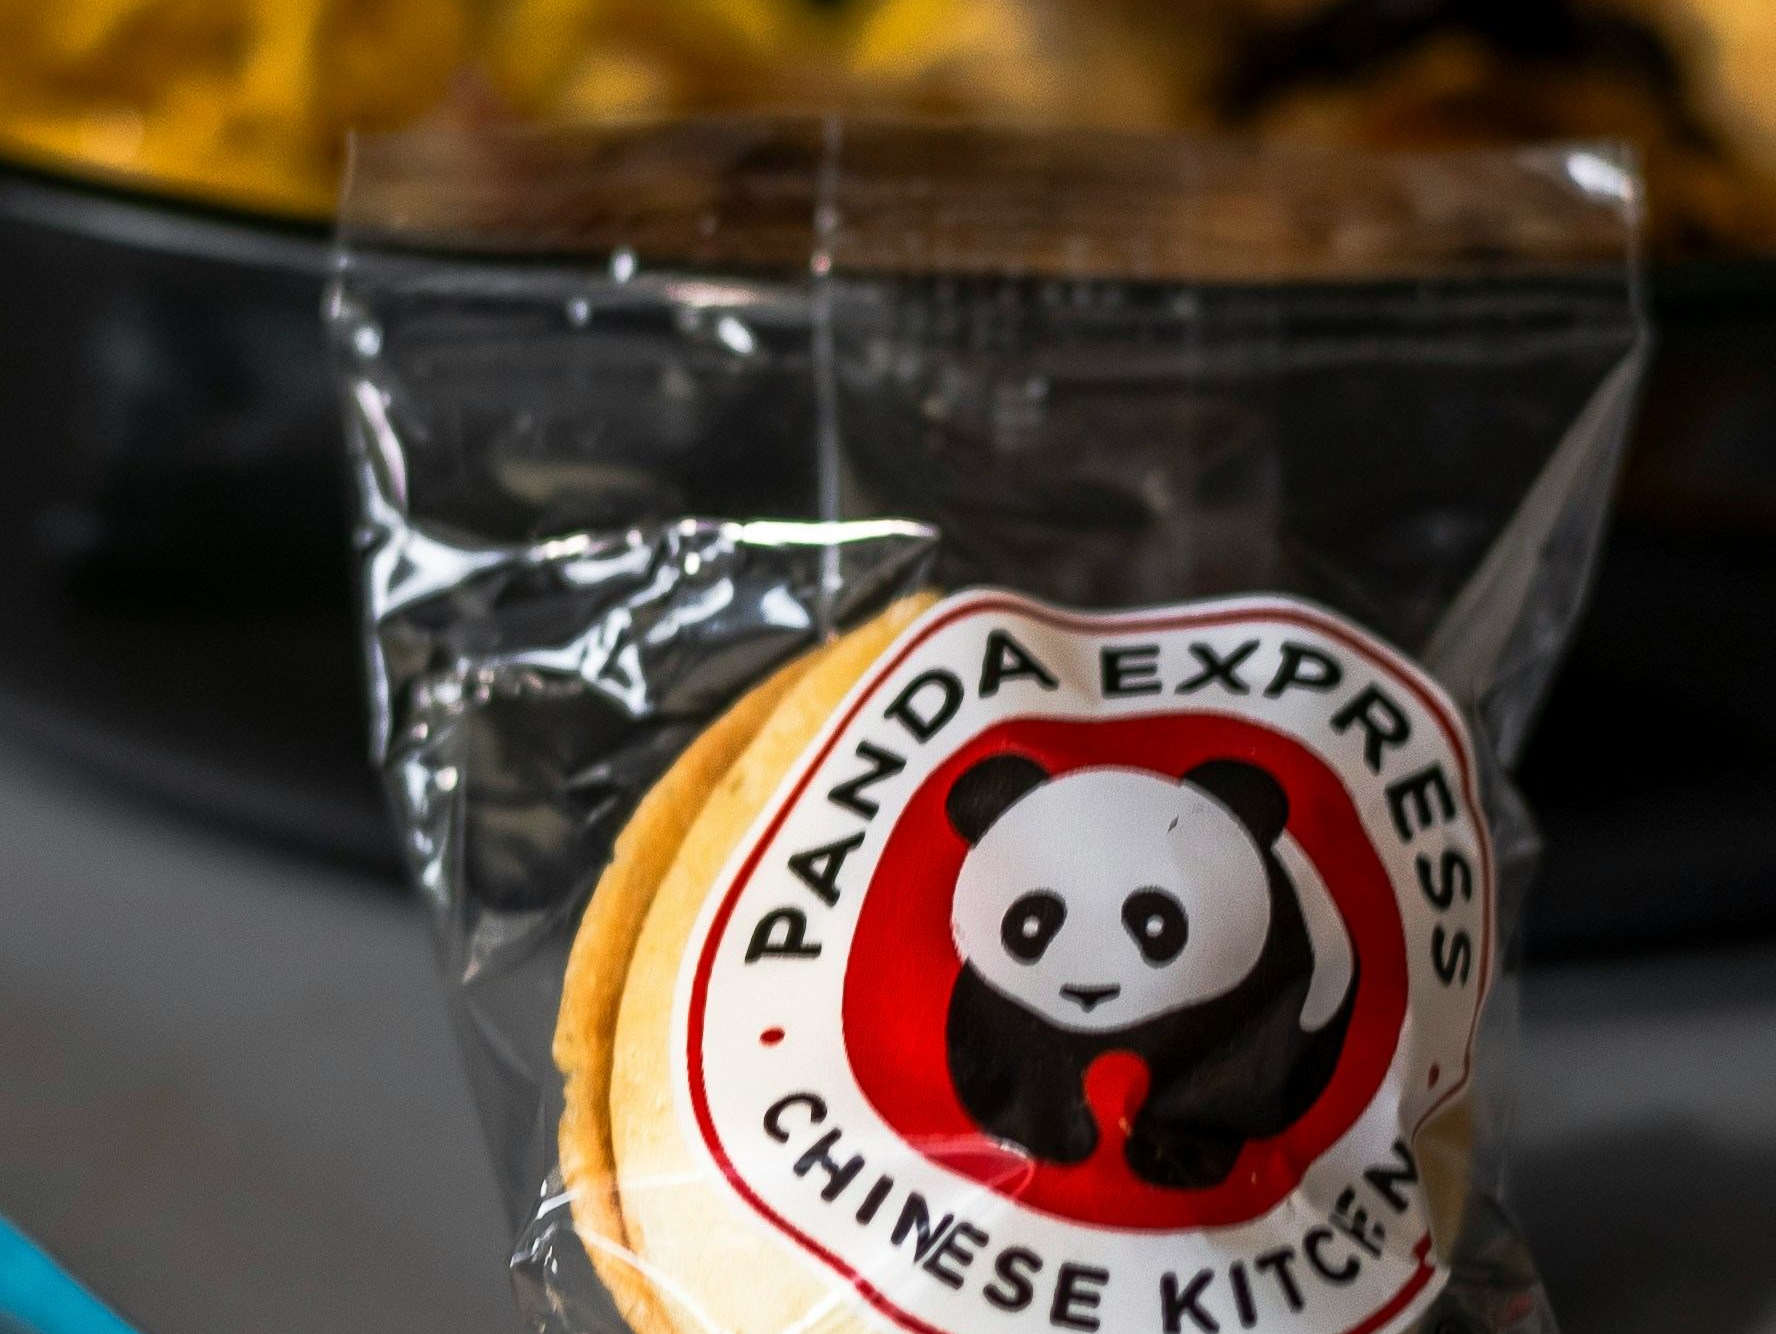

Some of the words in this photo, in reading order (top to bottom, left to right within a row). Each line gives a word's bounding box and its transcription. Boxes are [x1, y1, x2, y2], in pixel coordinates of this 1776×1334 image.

[746, 628, 1059, 968] PANDA
[1098, 637, 1473, 990] EXPRESS
[761, 1091, 1111, 1334] CHINESE
